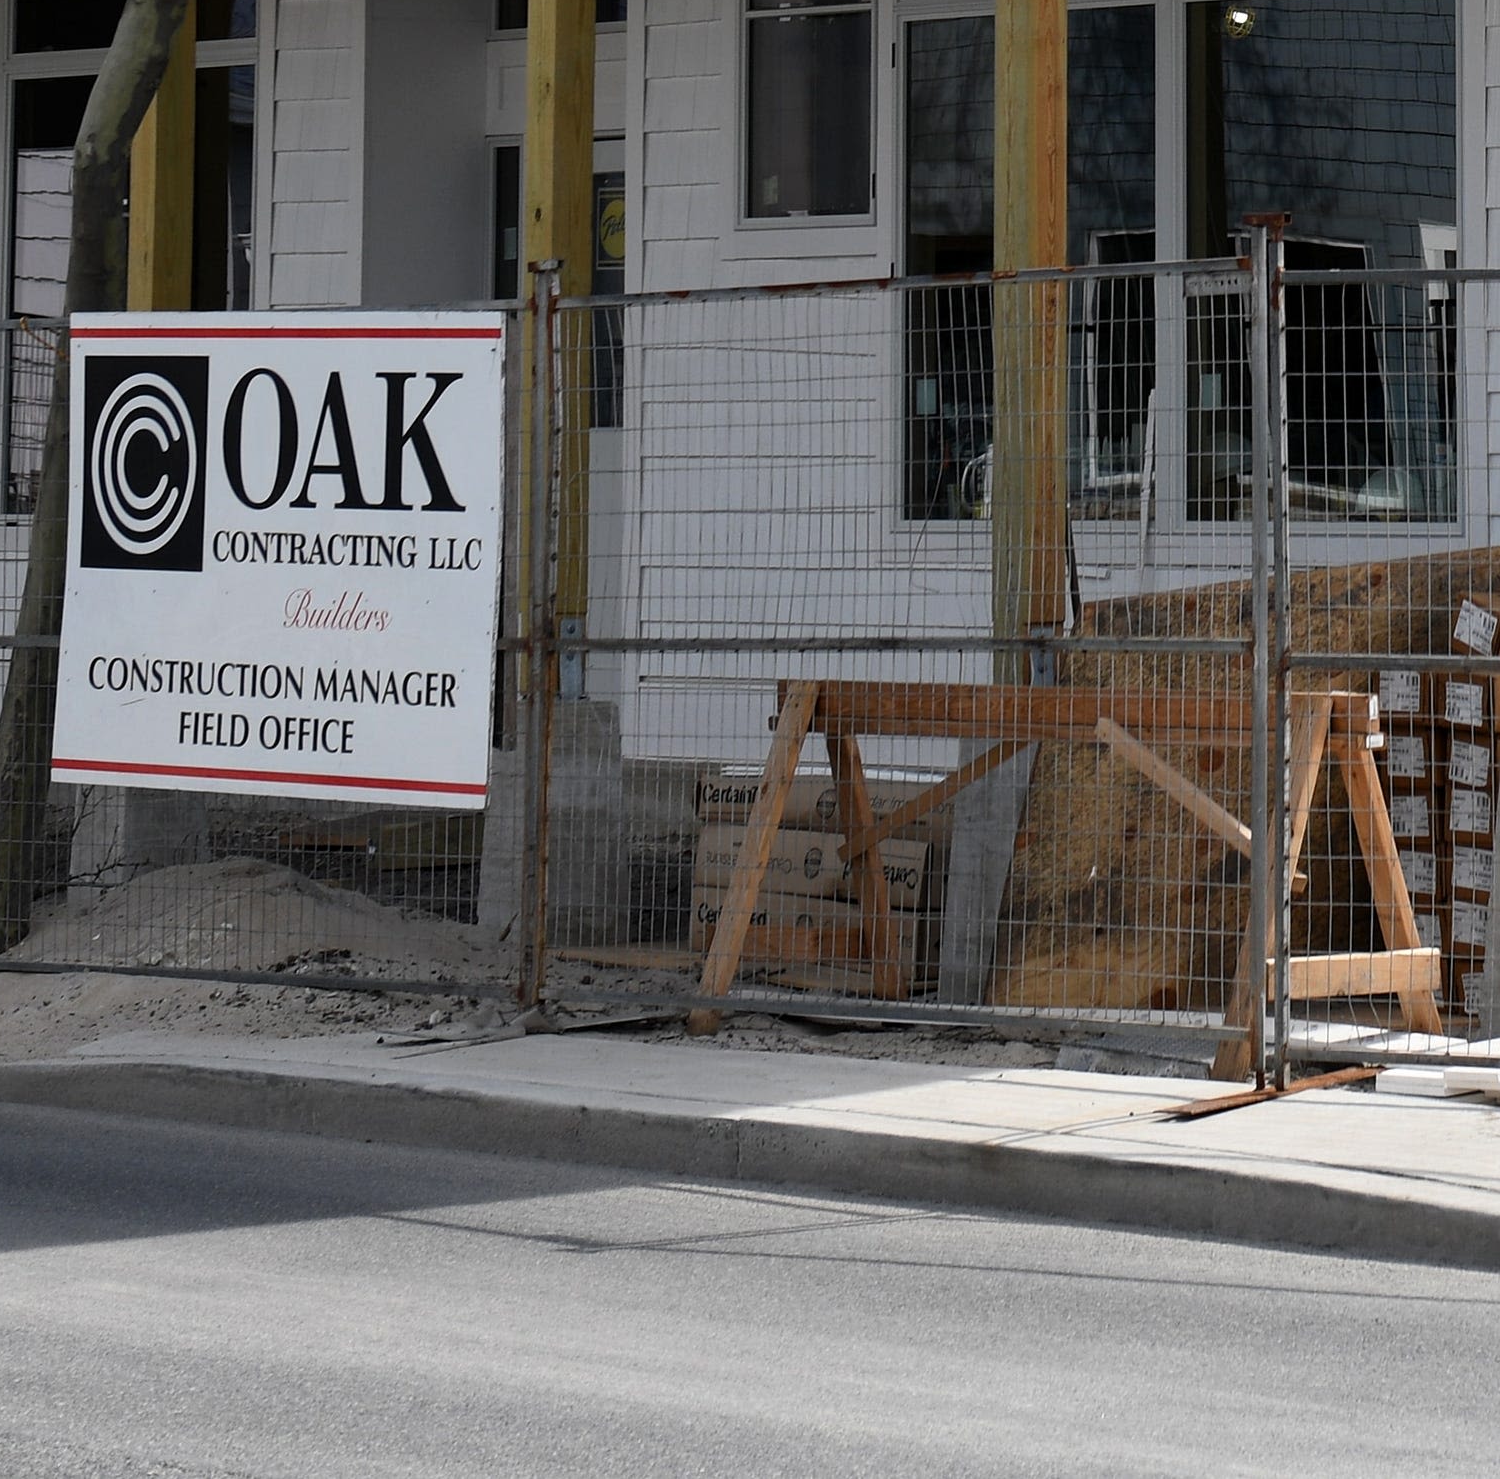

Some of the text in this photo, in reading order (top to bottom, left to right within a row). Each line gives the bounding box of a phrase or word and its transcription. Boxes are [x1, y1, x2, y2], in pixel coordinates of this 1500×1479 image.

[223, 366, 467, 513] OAK
[213, 530, 482, 571] CONTRACTING LLC
[283, 587, 392, 632] Builders
[88, 655, 457, 708] CONSTRUCTION MANAGER
[179, 711, 354, 754] FIELD OFFICE
